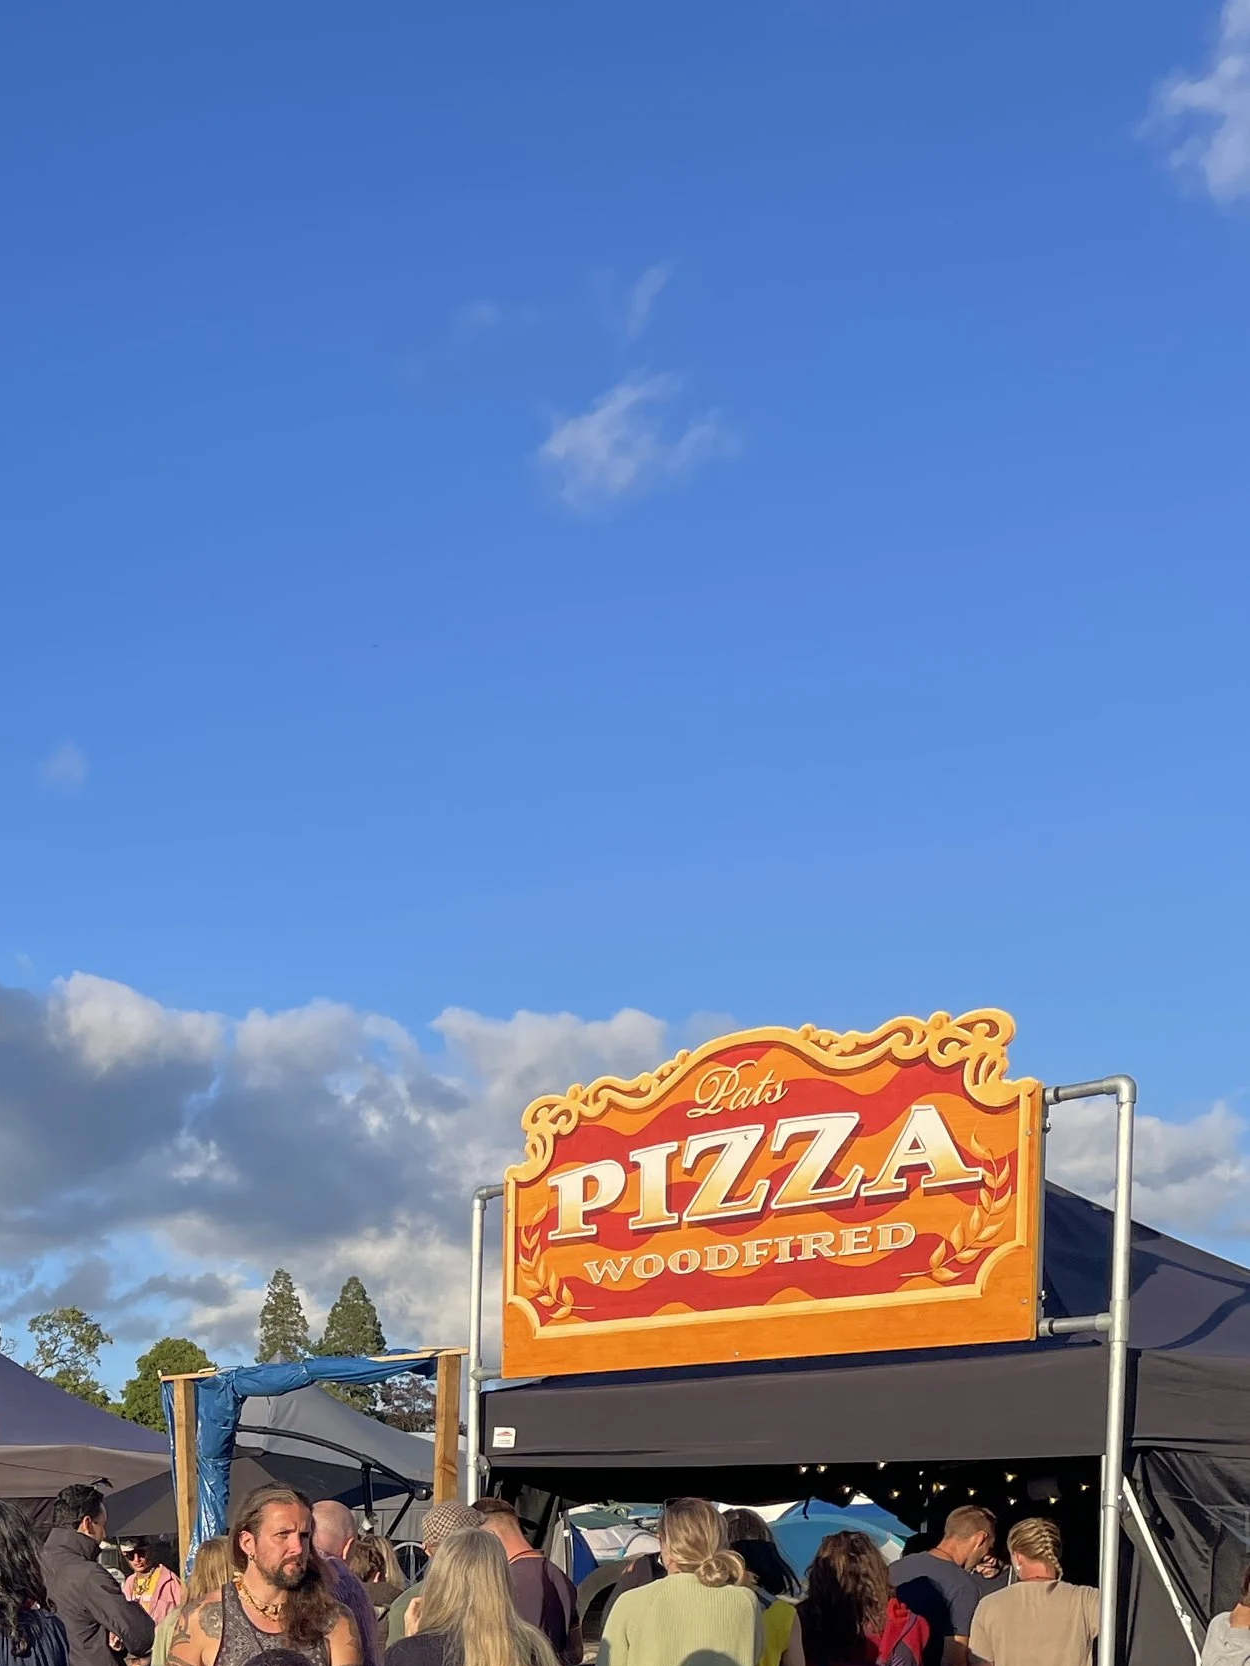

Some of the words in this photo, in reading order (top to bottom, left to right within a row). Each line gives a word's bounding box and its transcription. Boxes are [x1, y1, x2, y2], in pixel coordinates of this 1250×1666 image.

[687, 1061, 789, 1118] Pats
[548, 1105, 983, 1240] PIZZA
[583, 1221, 917, 1284] WOODFIRED
